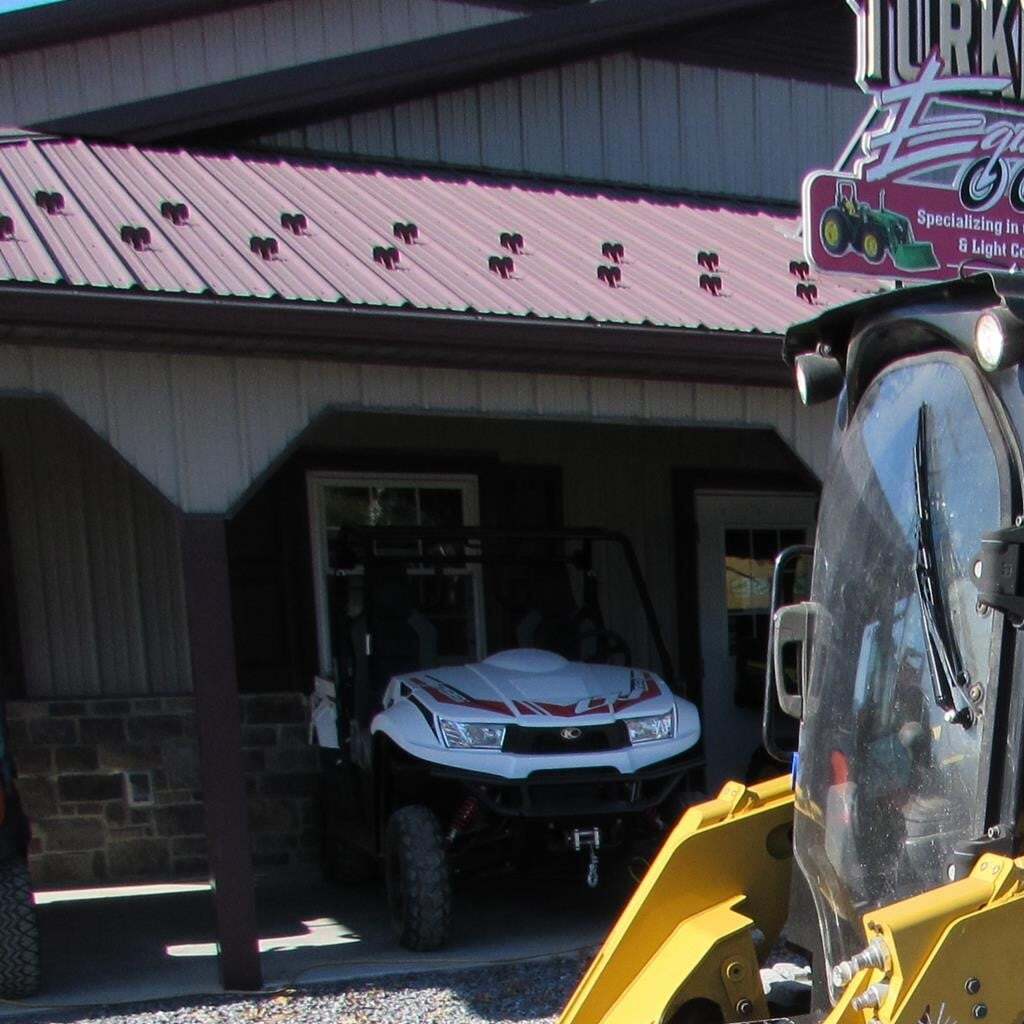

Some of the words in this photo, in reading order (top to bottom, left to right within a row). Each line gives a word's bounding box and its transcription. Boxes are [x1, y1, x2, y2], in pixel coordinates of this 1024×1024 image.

[917, 208, 1002, 236] Specializing
[1006, 220, 1019, 235] in
[958, 237, 968, 253] &
[972, 238, 1007, 259] Light
